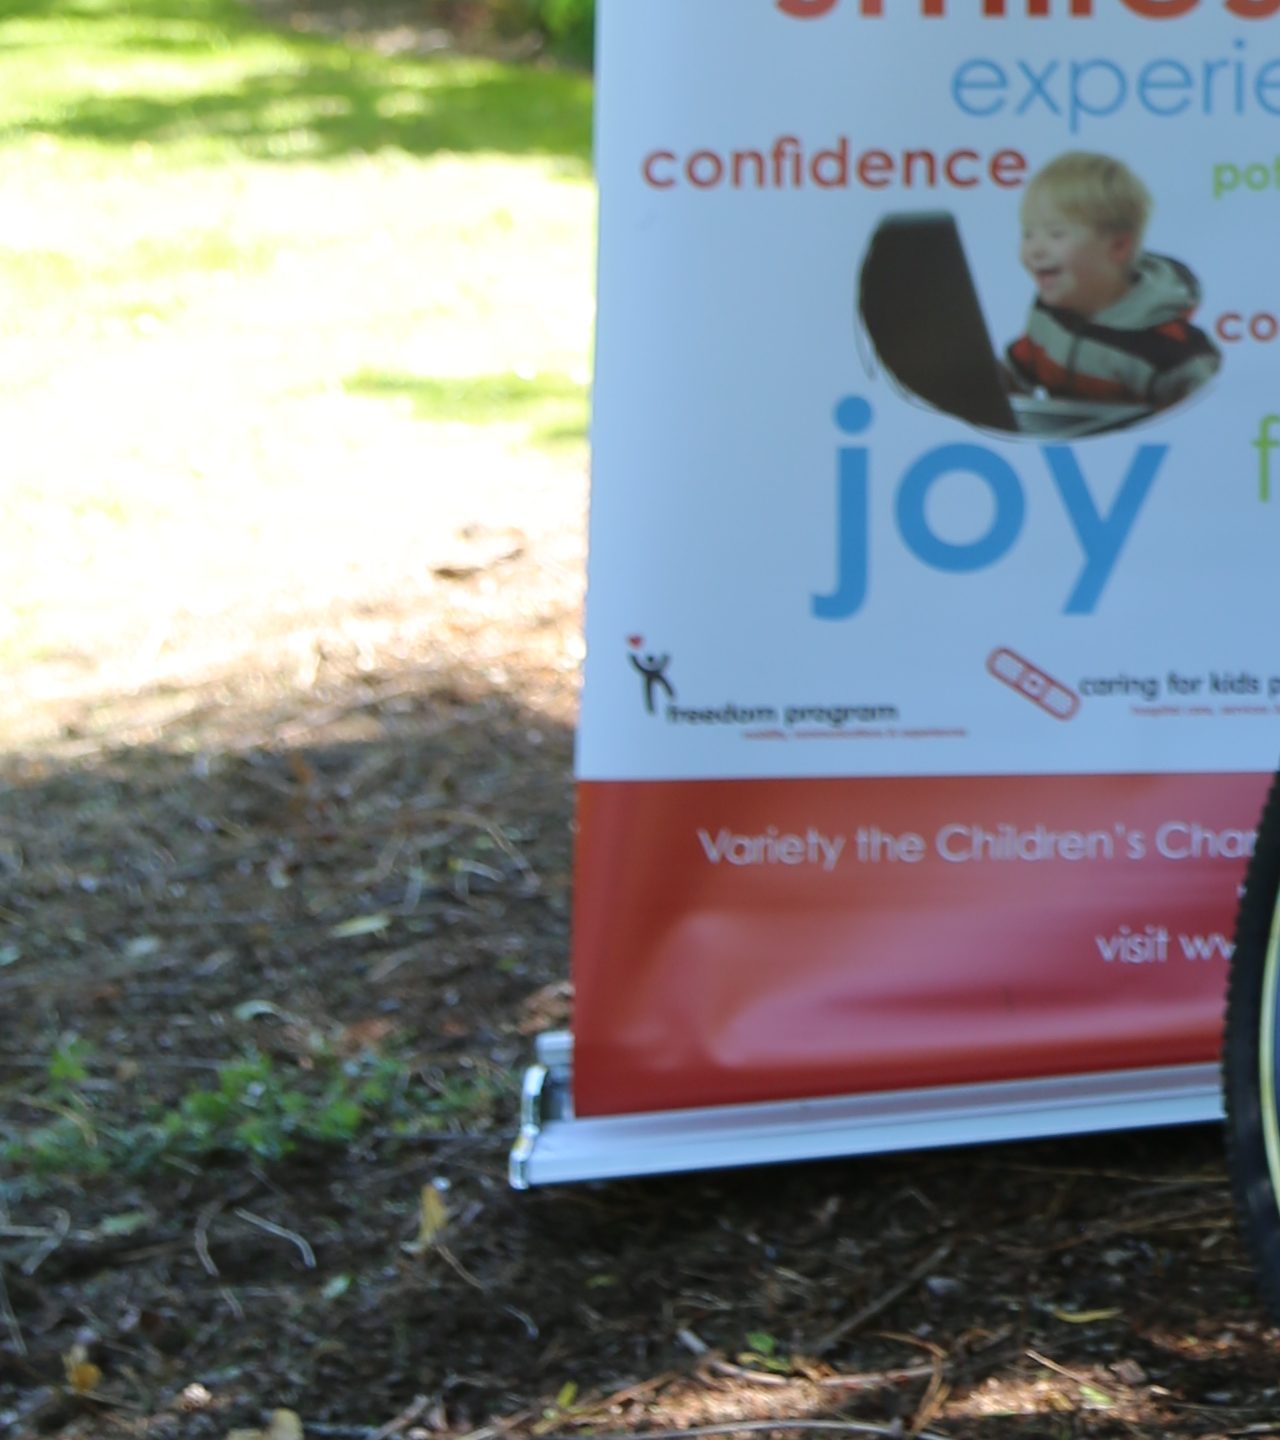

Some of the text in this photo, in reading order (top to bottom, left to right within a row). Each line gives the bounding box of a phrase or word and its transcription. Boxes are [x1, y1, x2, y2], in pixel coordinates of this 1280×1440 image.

[641, 136, 1027, 190] confidence
[811, 395, 1169, 620] joy
[1079, 674, 1160, 700] caring
[1168, 671, 1201, 694] for
[1209, 671, 1258, 694] kids
[667, 696, 897, 728] freedom program
[698, 828, 843, 871] Variety
[856, 826, 925, 863] the
[936, 822, 1146, 863] Children's
[1096, 926, 1168, 963] visit
